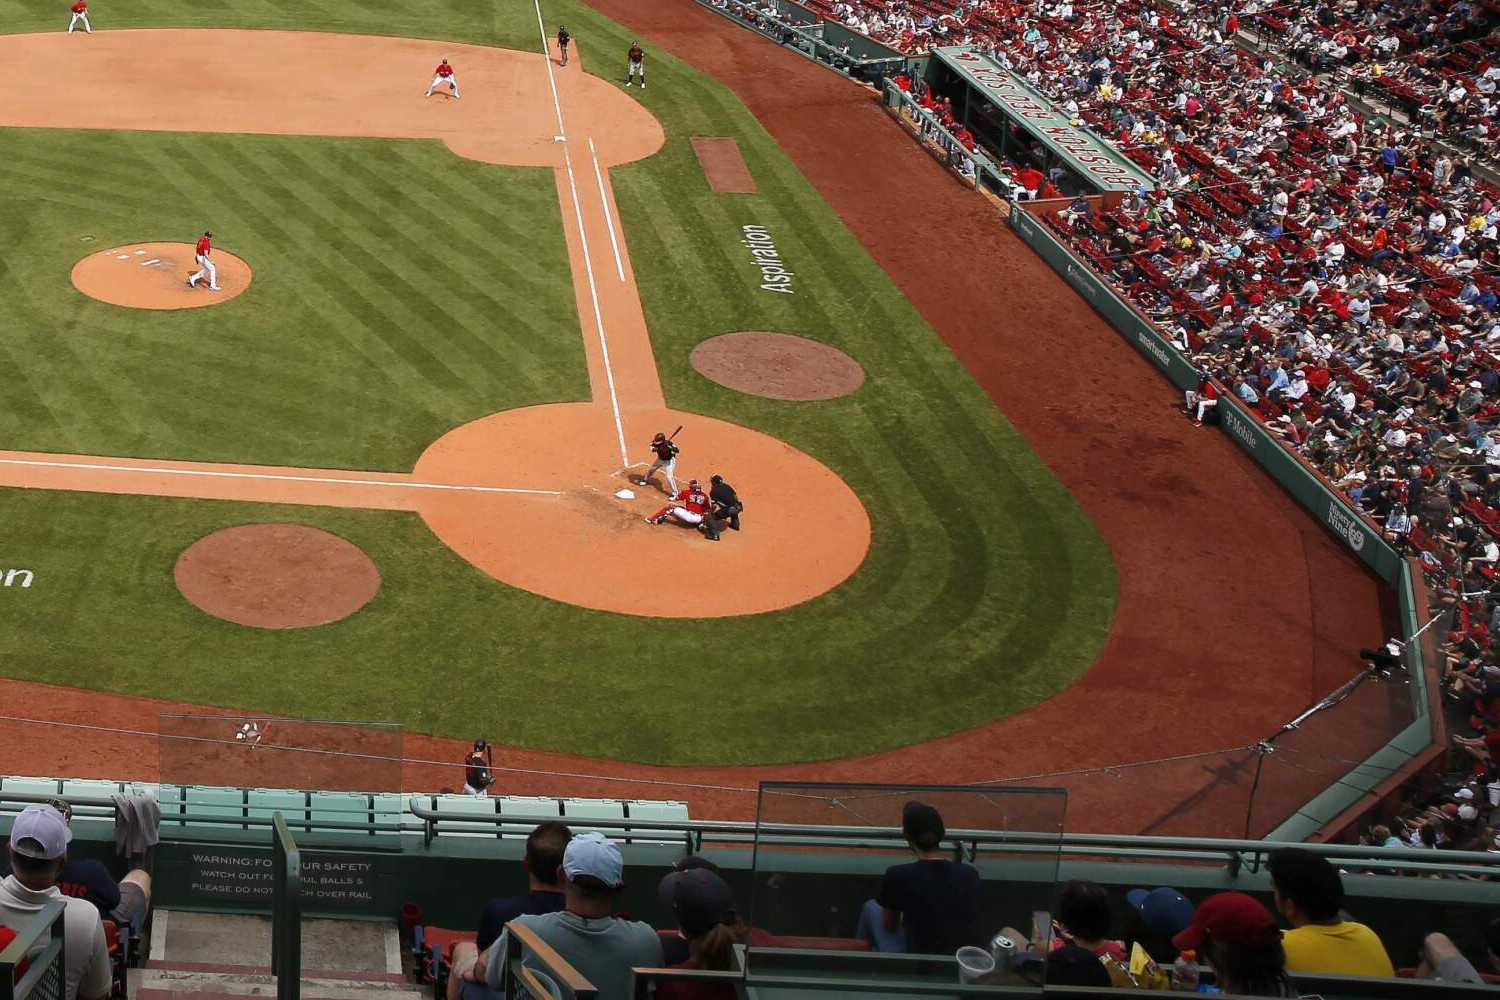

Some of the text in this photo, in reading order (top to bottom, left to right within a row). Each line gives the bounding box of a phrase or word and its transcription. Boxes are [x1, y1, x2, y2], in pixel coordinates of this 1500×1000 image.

[970, 67, 1144, 186] BOSTON RED SOX
[740, 224, 795, 294] Aspiration
[1138, 332, 1170, 367] smartwater
[1232, 416, 1257, 449] Mobile
[1328, 511, 1348, 538] Nine
[1329, 501, 1351, 528] Ninety
[192, 853, 372, 871] WARNING: FO SAFETY
[191, 882, 232, 893] PLEASE
[235, 886, 251, 894] DO
[316, 889, 346, 898] OVER
[349, 891, 373, 900] RAIL
[201, 869, 236, 880] WATCH
[238, 871, 259, 881] OUT
[320, 876, 354, 886] BALLS
